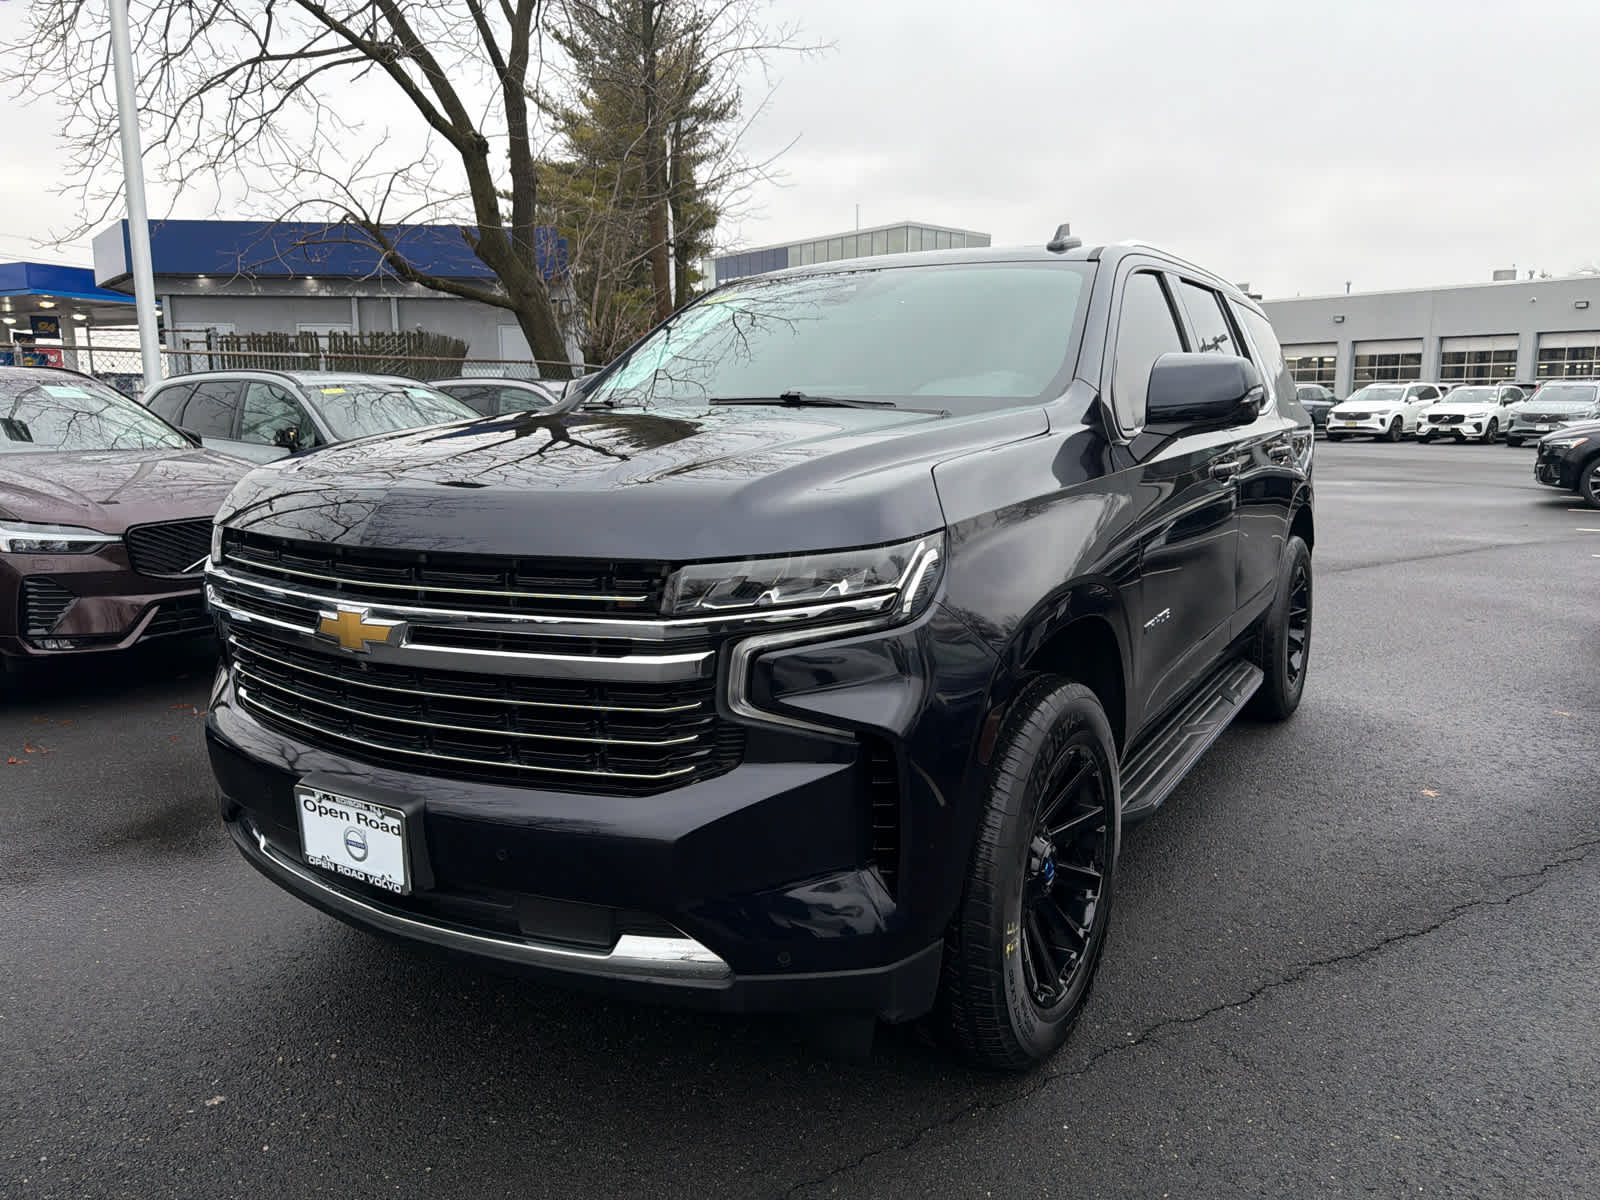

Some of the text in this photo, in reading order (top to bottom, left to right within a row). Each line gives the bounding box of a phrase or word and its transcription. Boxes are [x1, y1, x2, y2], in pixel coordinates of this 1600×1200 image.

[303, 799, 401, 836] Open Road
[309, 856, 401, 893] OPEN ROAD VOLVO
